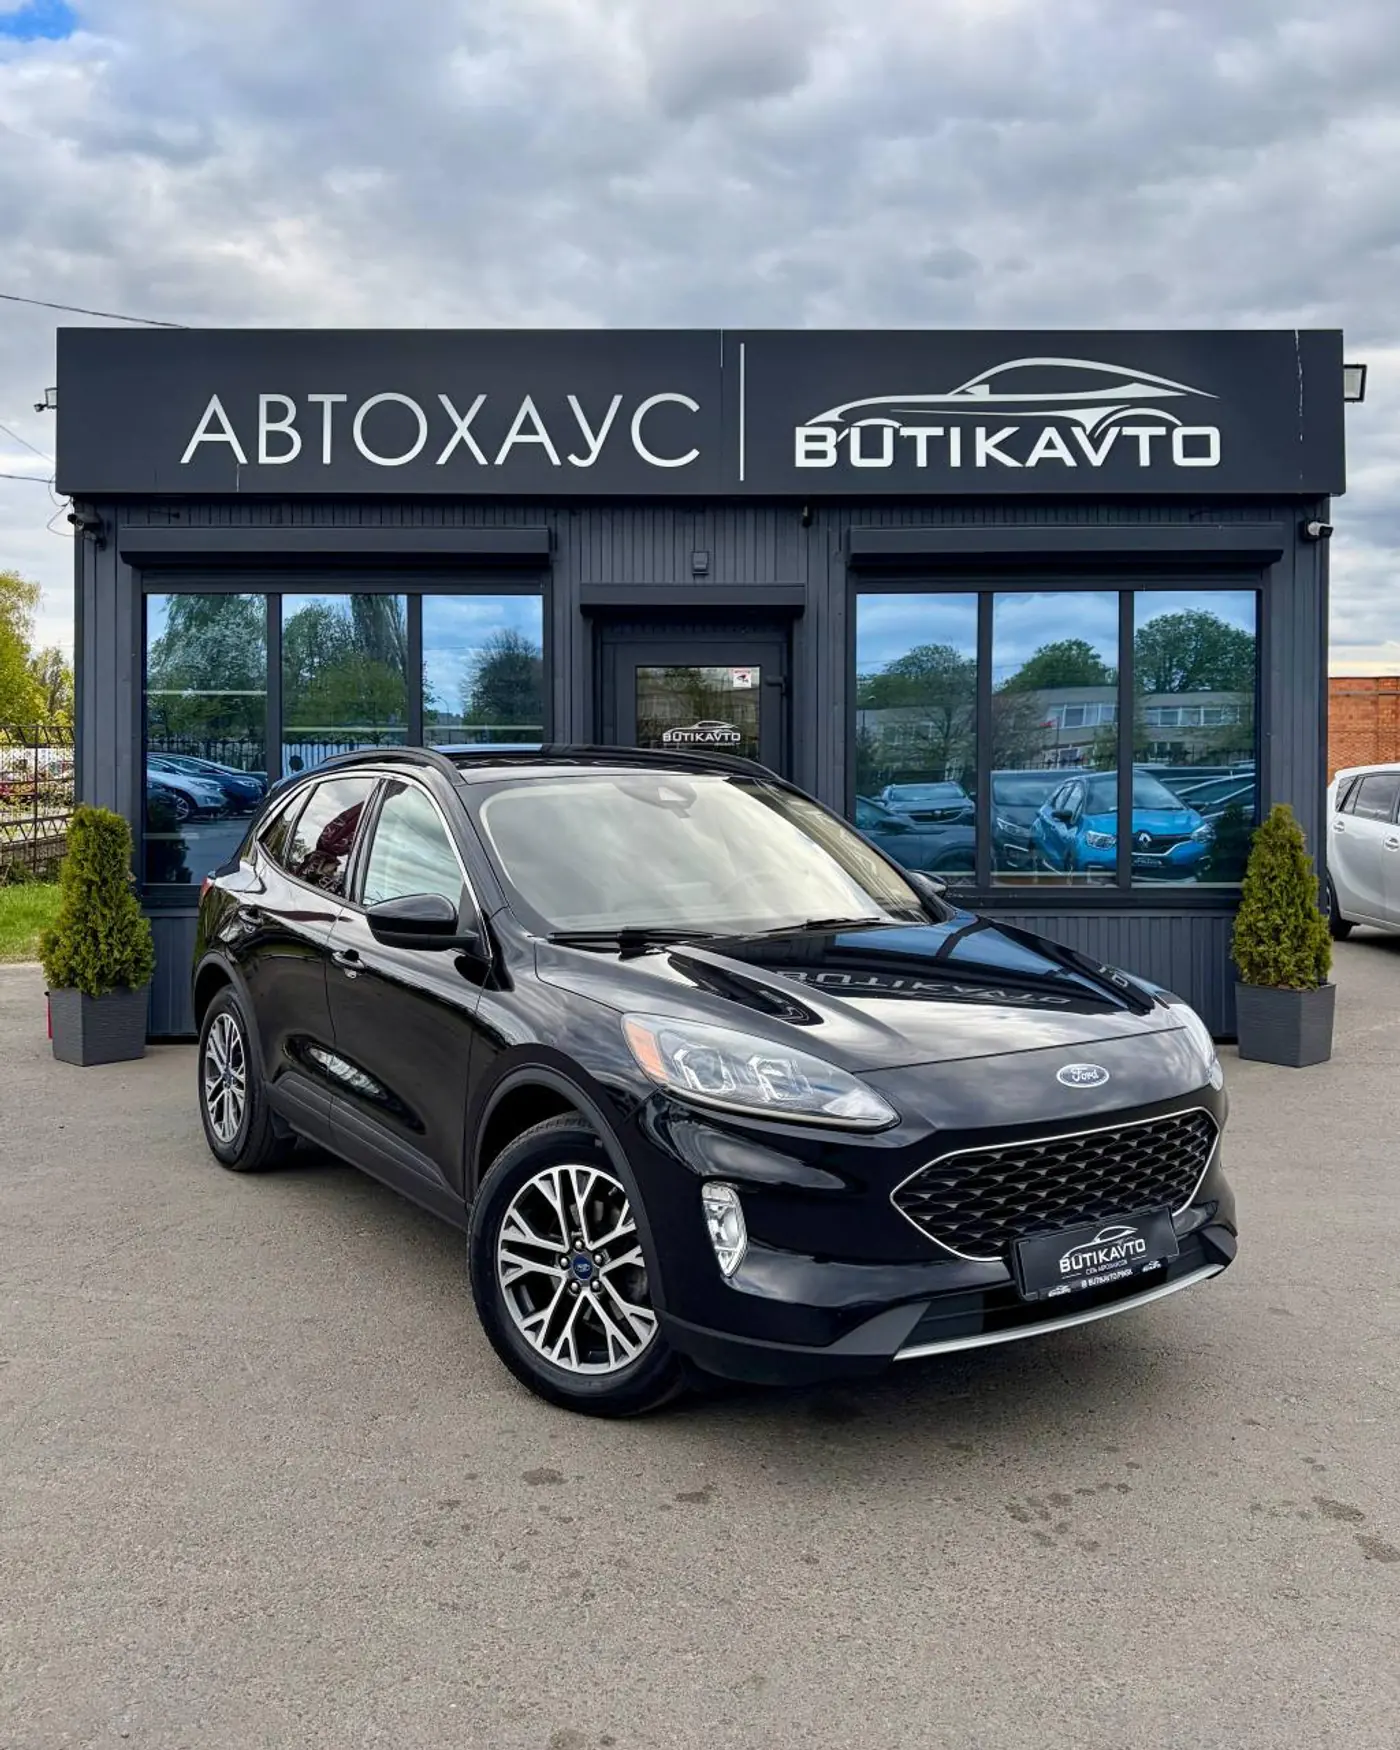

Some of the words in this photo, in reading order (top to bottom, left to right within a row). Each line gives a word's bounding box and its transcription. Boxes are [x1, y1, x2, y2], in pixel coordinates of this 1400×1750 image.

[180, 392, 700, 468] АВТОХАУС
[795, 425, 1221, 468] BUTIKAVTO
[662, 732, 741, 742] BUTIKAVTO
[1070, 1067, 1100, 1082] Ford
[1060, 1238, 1146, 1273] BUTIKAVTO
